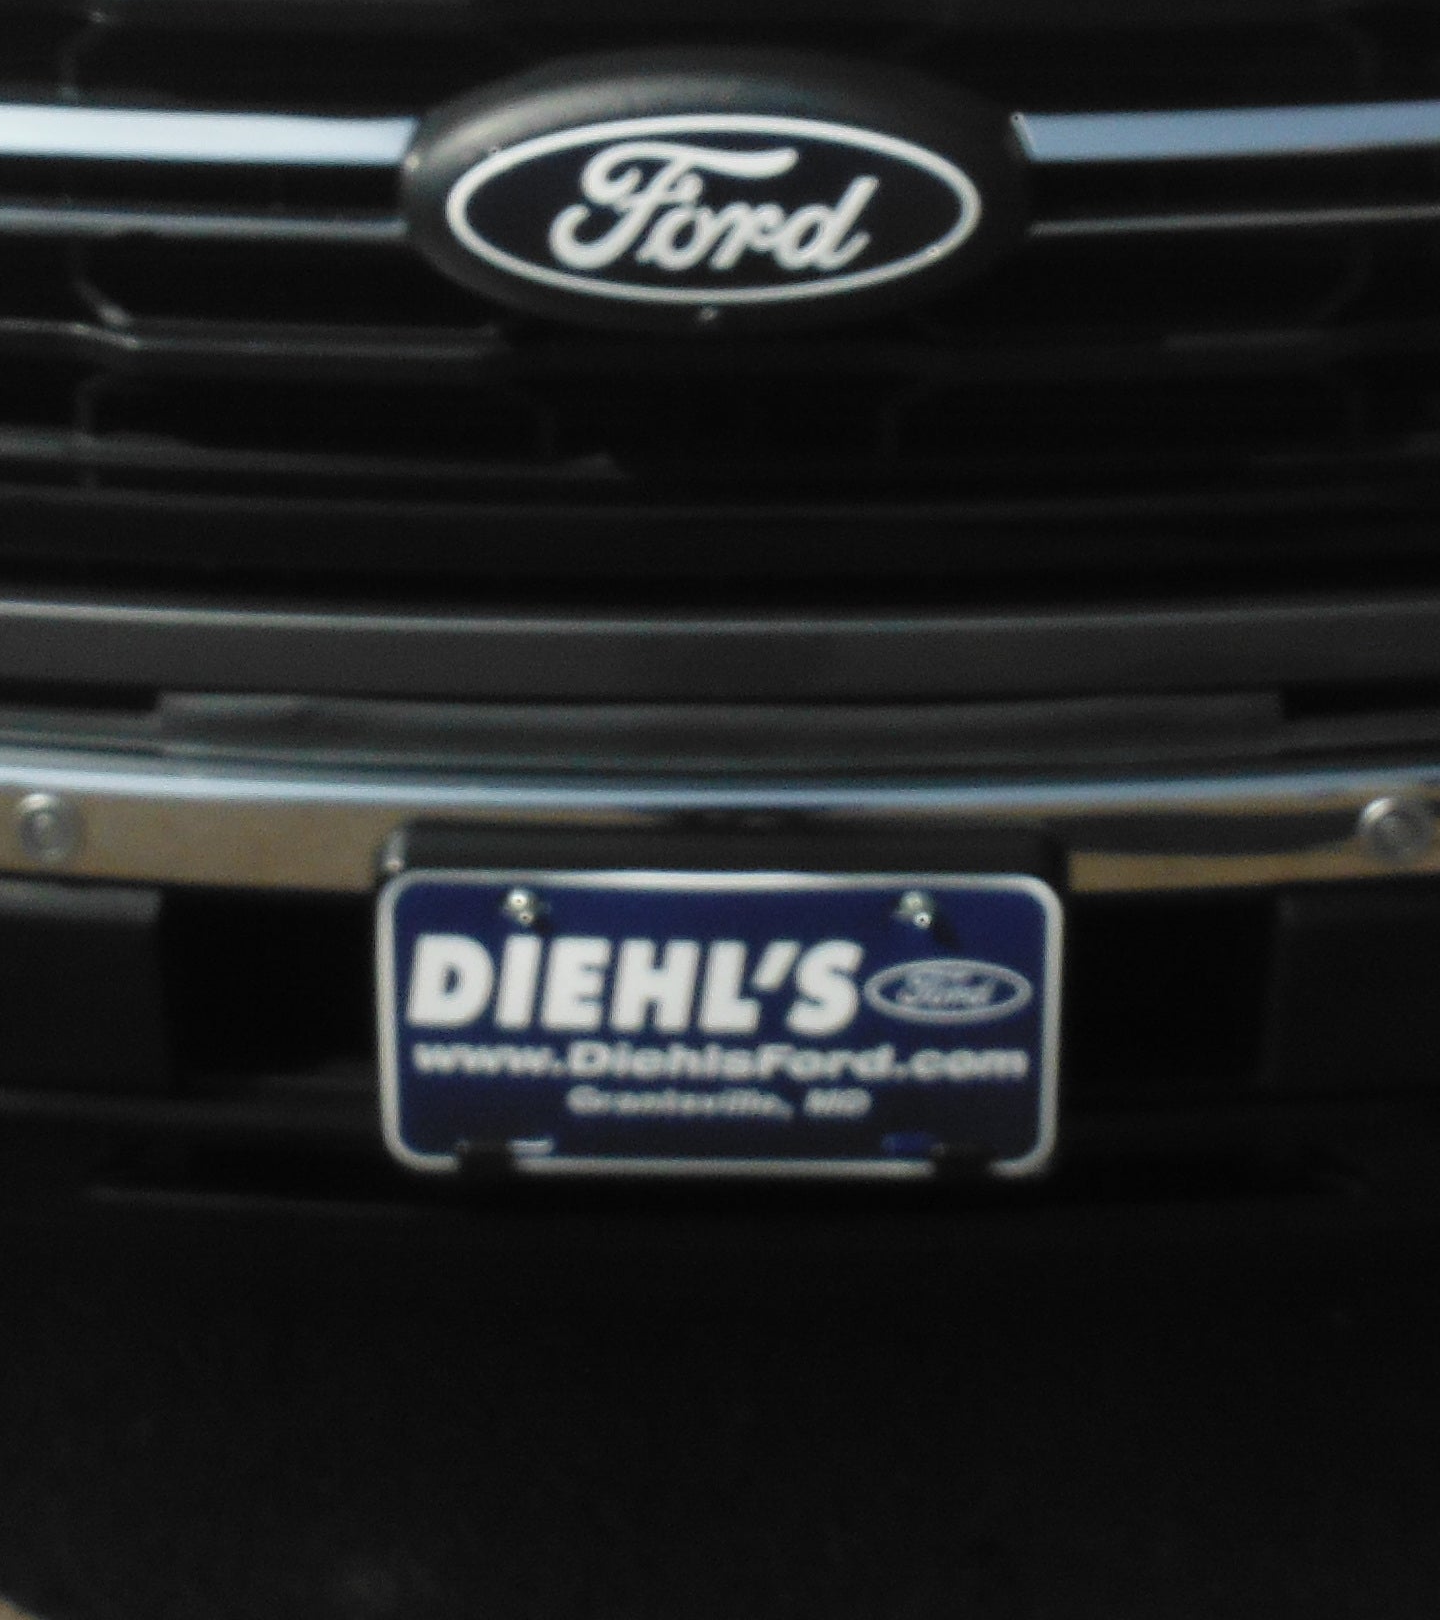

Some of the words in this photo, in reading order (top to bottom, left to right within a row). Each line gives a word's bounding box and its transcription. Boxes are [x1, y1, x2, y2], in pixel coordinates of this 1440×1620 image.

[549, 141, 880, 271] Ford
[407, 933, 866, 1035] DIEHL'S
[412, 1041, 1029, 1079] www.DiehlsFord.com
